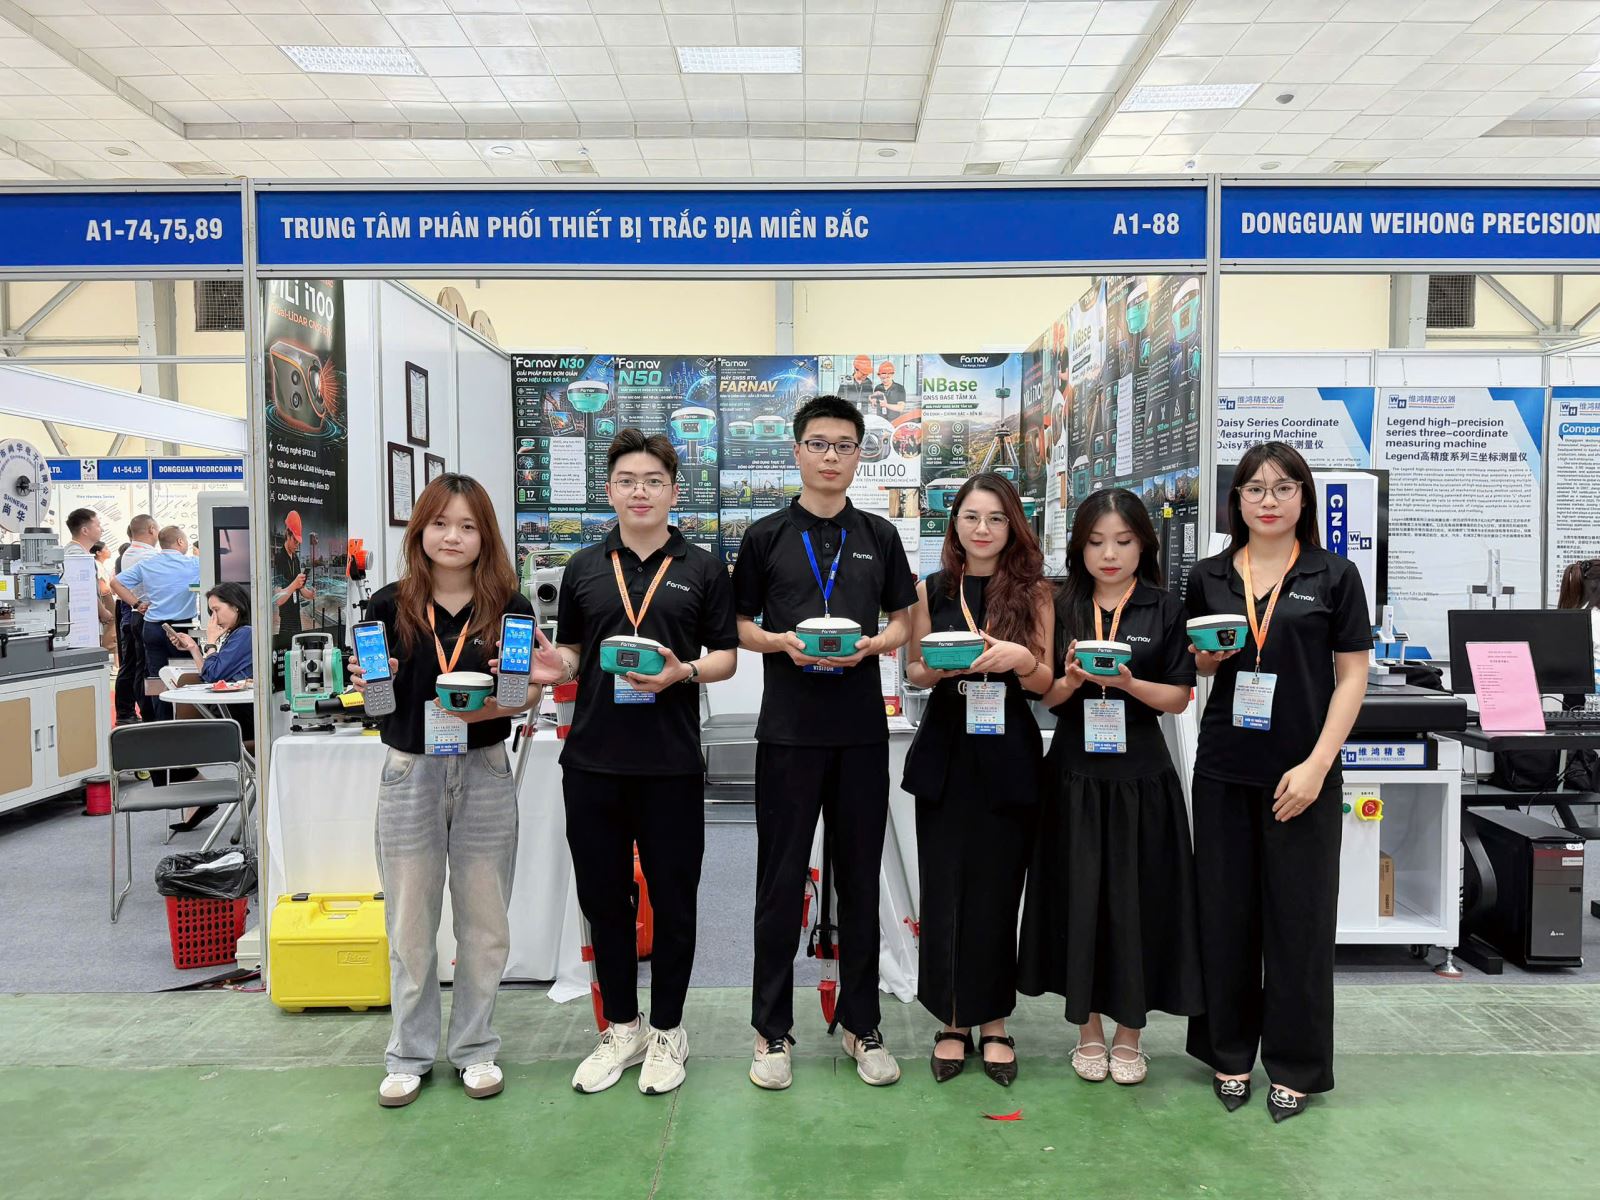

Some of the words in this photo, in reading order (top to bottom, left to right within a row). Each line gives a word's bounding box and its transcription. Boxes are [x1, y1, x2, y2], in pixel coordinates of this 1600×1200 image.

[280, 217, 355, 239] TRUNG
[363, 211, 411, 239] TÂM
[419, 210, 480, 239] PHÂN
[488, 208, 541, 238] PHỐI
[548, 208, 613, 239] THIẾT
[620, 216, 642, 244] BỊ
[649, 208, 707, 239] TRẮC
[714, 216, 753, 244] ĐỊA
[760, 208, 817, 239] MIỀN
[825, 208, 869, 239] BẮC
[1112, 212, 1180, 235] A1-88
[1241, 212, 1363, 235] DONGGUAN
[1370, 212, 1475, 235] WEIHONG
[1482, 212, 1600, 235] PRECISION
[86, 218, 223, 244] A1-74,75,89
[516, 357, 557, 368] Farnav
[559, 358, 585, 369] N30
[618, 358, 660, 369] Farnav
[721, 358, 748, 367] Farnav
[960, 355, 989, 364] Farnav
[618, 370, 663, 386] N50
[720, 380, 778, 393] FARNAV
[923, 377, 977, 392] NBase
[1237, 396, 1285, 404] 维鸿精密仪器
[1408, 395, 1456, 404] 维鸿精密仪器
[1216, 418, 1244, 428] Daisy
[1246, 418, 1279, 427] Series
[1281, 418, 1339, 427] Coordinate
[1387, 417, 1425, 428] Legend
[1428, 417, 1504, 428] high-precision
[1218, 429, 1271, 440] Measuring
[1273, 429, 1317, 439] Machine
[1385, 428, 1417, 437] series
[1419, 428, 1508, 438] three-coordinate
[1385, 439, 1441, 449] measuring
[1443, 439, 1487, 448] machine
[276, 444, 290, 455] Công
[289, 447, 302, 457] nghệ
[541, 456, 549, 464] 02
[1385, 451, 1528, 462] Legend高精度系列三坐标测量仪
[158, 465, 194, 474] DONGGUAN
[195, 465, 233, 474] VIGORCONN
[276, 460, 290, 469] Khảo
[277, 476, 288, 485] Tính
[288, 478, 299, 486] toán
[541, 473, 549, 481] 03
[526, 490, 535, 498] 17
[541, 489, 550, 497] 04
[3, 493, 29, 511] SHINEWA
[297, 495, 310, 503] visual
[666, 580, 691, 592] Farnav
[1289, 591, 1315, 602] Farnav
[1126, 635, 1151, 643] Farnav
[1358, 746, 1406, 756] 维鸿精密
